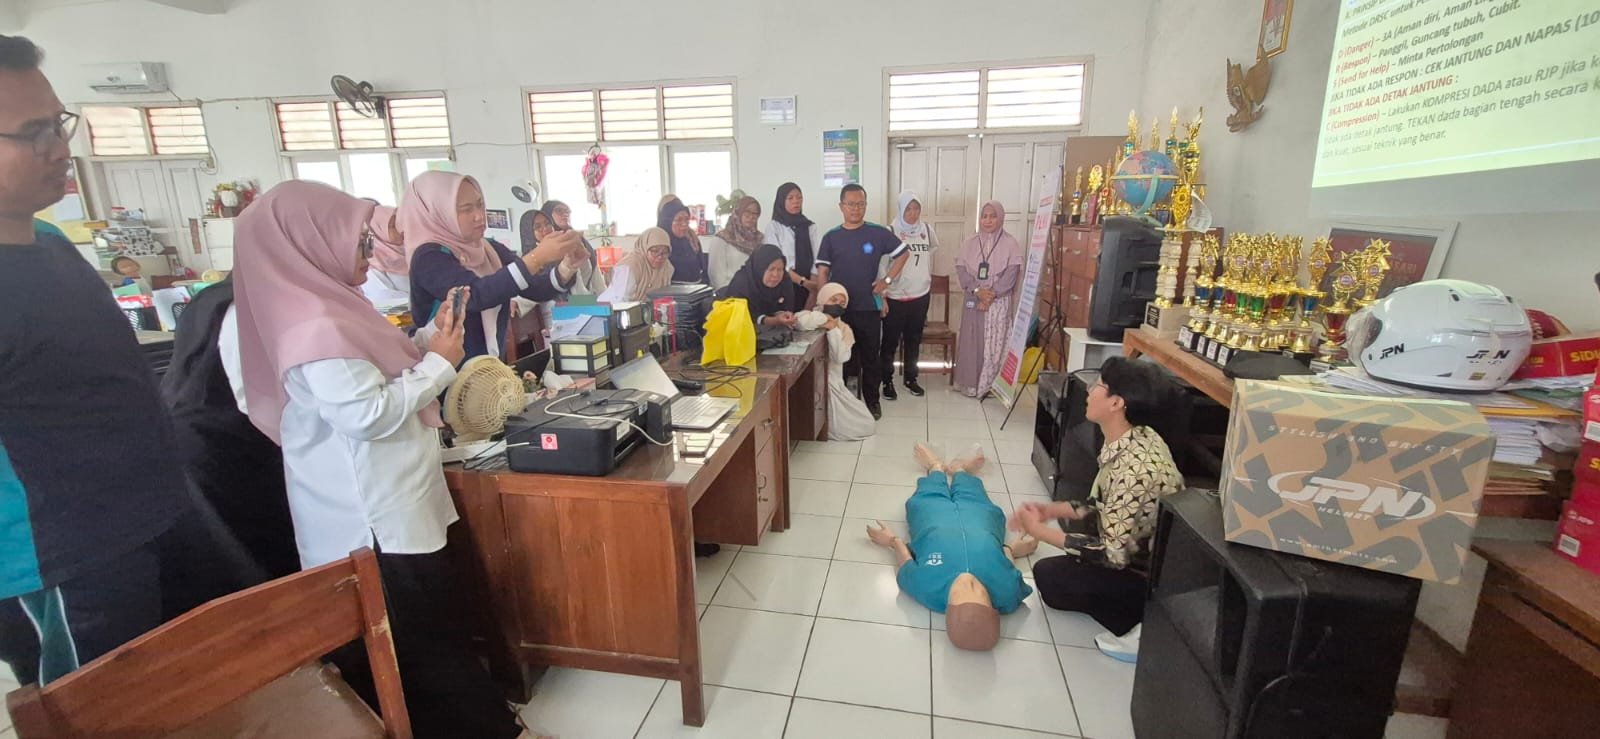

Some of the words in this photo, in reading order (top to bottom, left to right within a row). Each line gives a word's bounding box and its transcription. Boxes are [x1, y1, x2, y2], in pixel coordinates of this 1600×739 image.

[1344, 37, 1375, 57] (Danger)
[1394, 20, 1422, 39] (Aman
[1423, 11, 1441, 25] diri,
[1443, 0, 1473, 18] Aman
[1390, 1, 1414, 18] untuk
[1341, 53, 1372, 74] (Respon)
[1378, 40, 1409, 59] Panggil,
[1411, 25, 1452, 47] Guncang
[1453, 11, 1486, 31] tubuh,
[1489, 0, 1522, 19] Cubit.
[1338, 70, 1357, 88] (Send
[1358, 66, 1369, 79] for
[1370, 61, 1391, 76] Help)
[1398, 53, 1424, 67] Minta
[1425, 31, 1485, 57] Pertolongan
[1346, 84, 1366, 98] TIDAK
[1367, 79, 1384, 92] ADA
[1385, 68, 1419, 86] RESPON
[1425, 61, 1442, 75] CEK
[1443, 45, 1493, 69] JANTUNG
[1495, 35, 1523, 54] DAN
[1524, 19, 1573, 45] NAPAS
[1331, 109, 1381, 132] (Compression)
[1388, 102, 1421, 117] Lakukan
[1422, 88, 1471, 109] KOMPRESI
[1473, 80, 1503, 97] DADA
[1505, 74, 1533, 89] atau
[1535, 65, 1560, 83] RJP
[1560, 59, 1587, 80] jika
[1343, 100, 1363, 113] TIDAK
[1365, 95, 1381, 107] ADA
[1382, 88, 1408, 103] DETAK
[1409, 75, 1454, 96] JANTUNG
[1407, 112, 1437, 128] TEKAN
[1438, 108, 1461, 123] dada
[1463, 102, 1497, 117] bagian
[1500, 91, 1542, 109] tengah
[1544, 82, 1590, 101] secara
[1399, 135, 1417, 147] yang
[914, 254, 920, 266] 7
[1379, 343, 1406, 360] JPN
[1267, 425, 1339, 440] STYLISH
[1348, 435, 1379, 444] AND
[1387, 440, 1462, 455] SAFETY
[1279, 476, 1423, 517] JPN
[1318, 506, 1373, 521] HELMET
